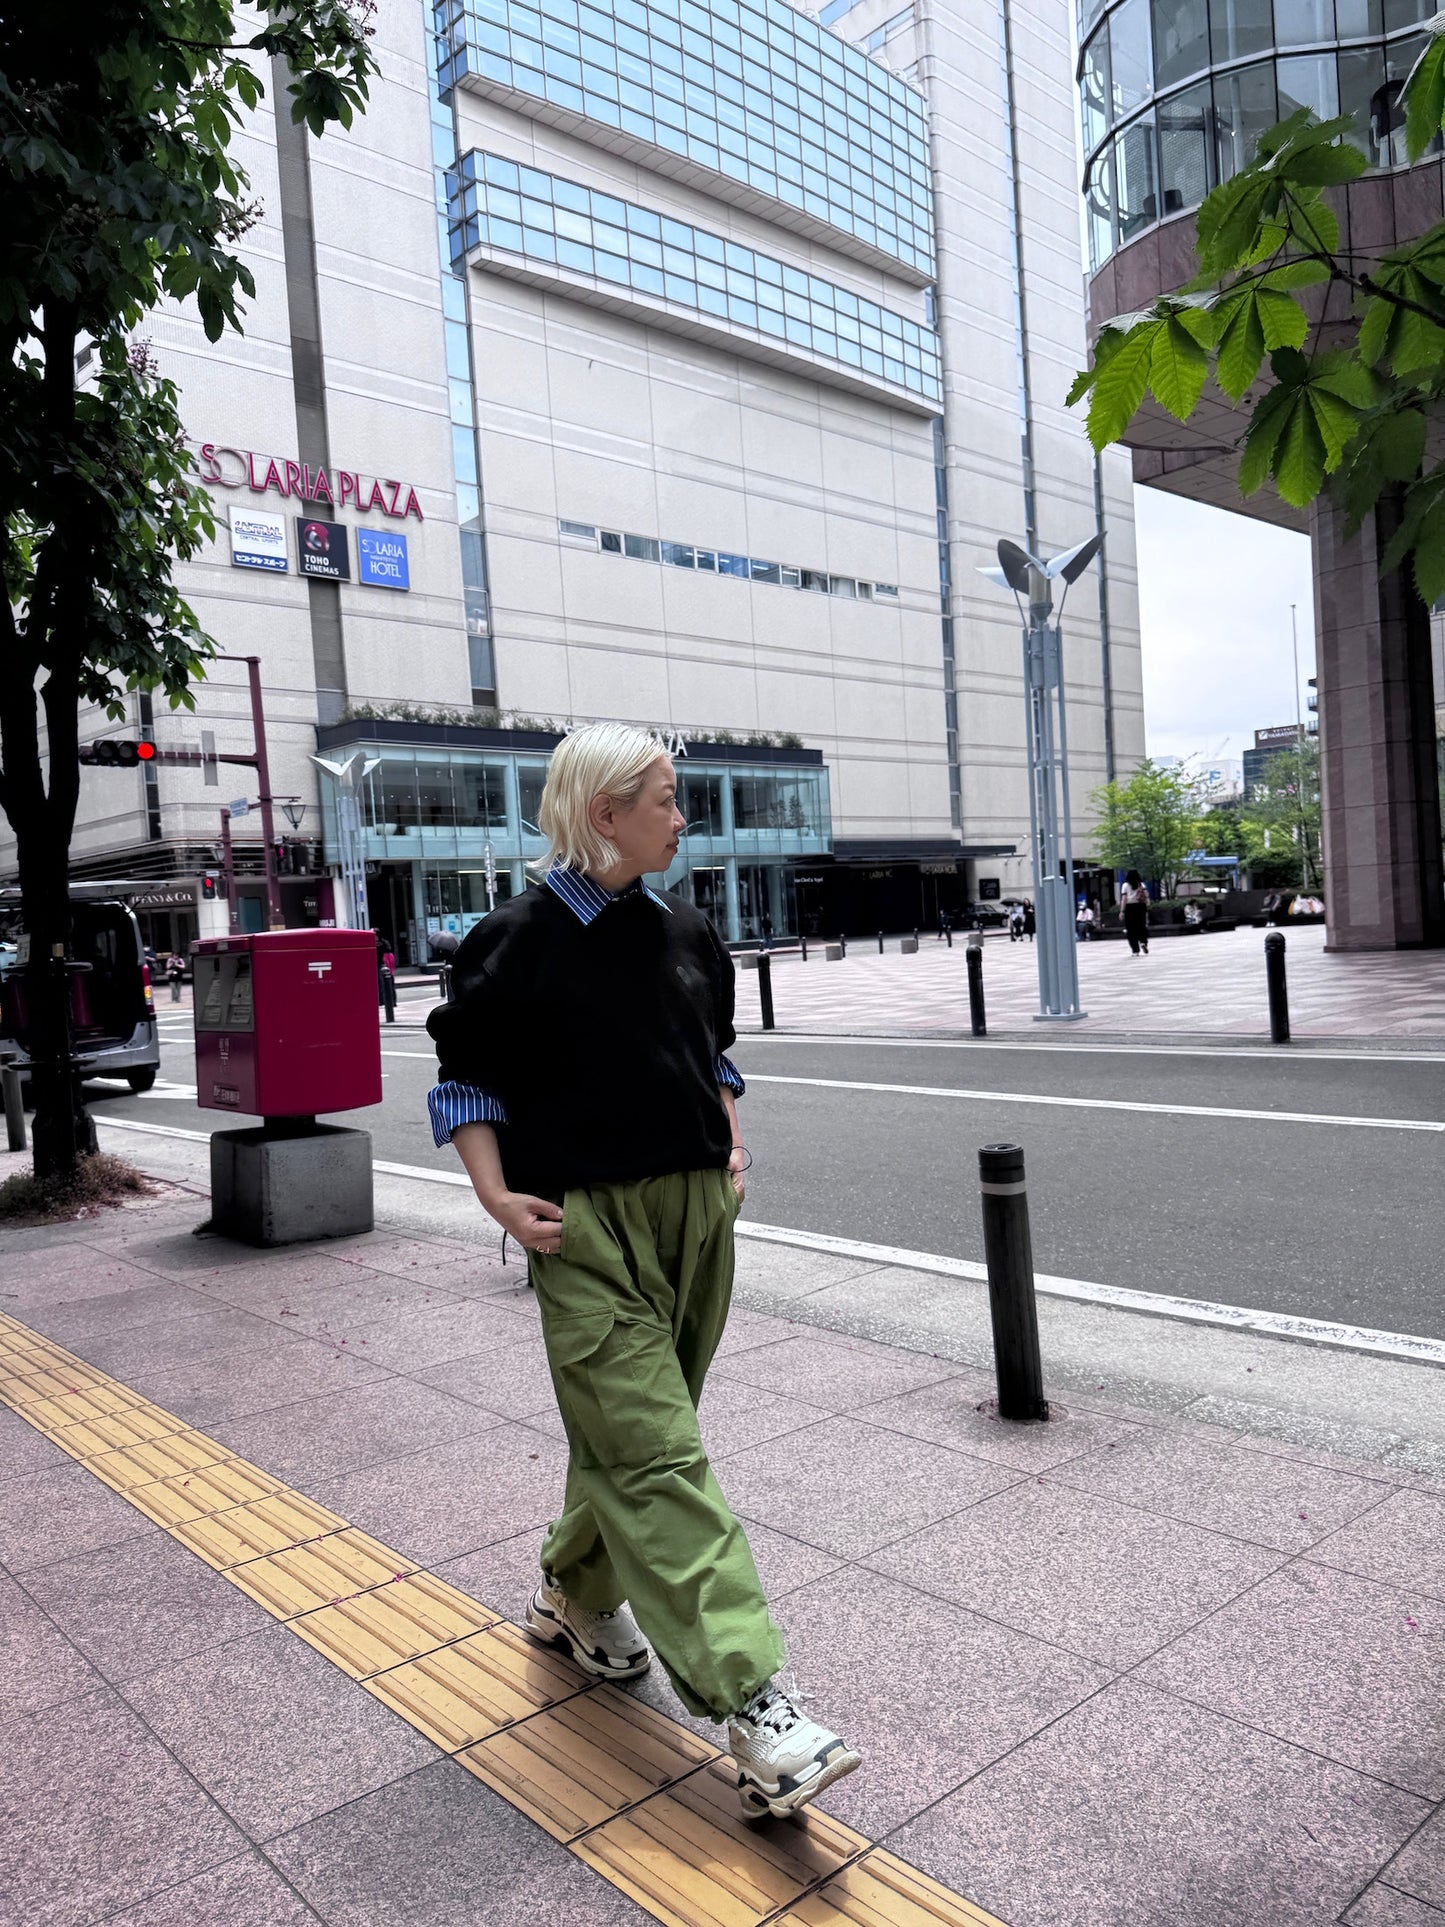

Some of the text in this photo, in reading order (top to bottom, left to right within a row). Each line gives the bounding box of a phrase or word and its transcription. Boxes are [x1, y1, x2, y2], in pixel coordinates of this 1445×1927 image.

[201, 443, 424, 521] SOLARIA PLAZA
[362, 538, 405, 559] SOLARIA
[304, 554, 330, 566] TOHO
[304, 563, 340, 575] CINEMAS
[370, 561, 402, 578] HOTEL
